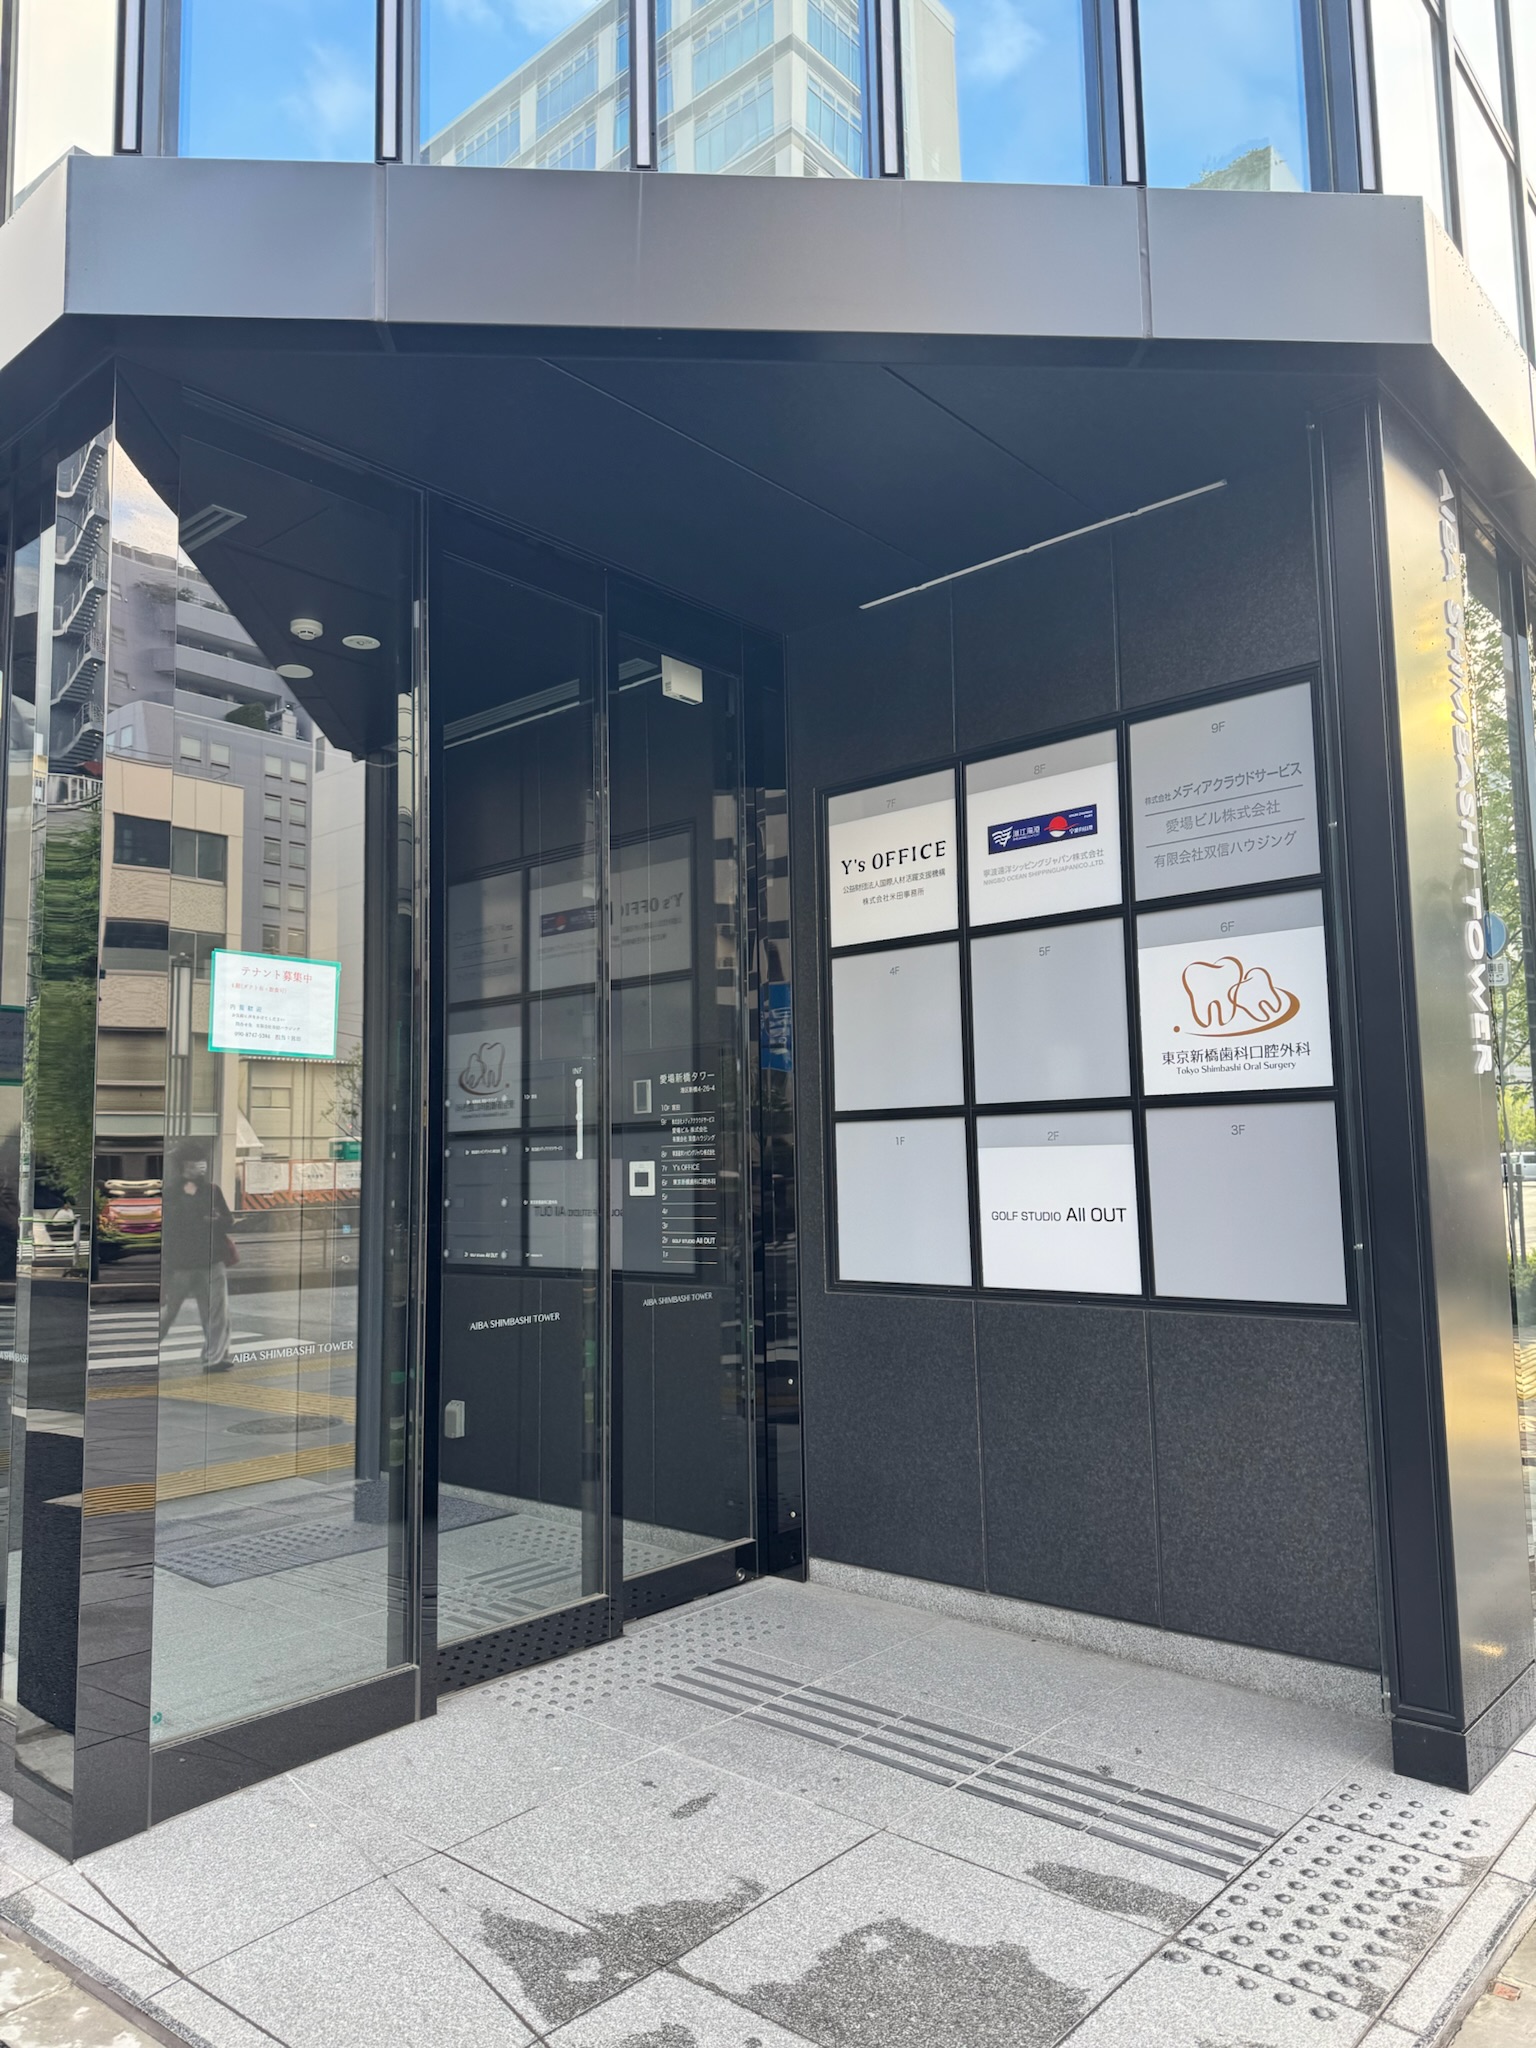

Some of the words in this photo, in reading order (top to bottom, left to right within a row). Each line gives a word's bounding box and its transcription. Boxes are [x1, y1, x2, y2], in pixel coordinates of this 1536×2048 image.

[1438, 468, 1457, 582] AIBA
[1211, 721, 1226, 734] 9F
[1444, 599, 1478, 868] SHIMBASHI
[1033, 763, 1046, 775] 8F
[886, 799, 896, 809] 7F
[1165, 799, 1281, 834] 愛場ビル株式会社
[1153, 830, 1298, 869] 有限会社双信ハウジング
[841, 858, 866, 875] Y's
[872, 840, 947, 870] OFFICE
[1006, 872, 1027, 882] OCEAN
[1220, 920, 1235, 933] 6F
[1038, 946, 1051, 957] 5F
[241, 966, 313, 984] テナント募集中
[889, 966, 900, 976] 4F
[1462, 888, 1491, 1074] TOWER
[1161, 1041, 1311, 1066] 東京新橋歯科口腔外科
[1176, 1066, 1200, 1076] Tokyo
[1201, 1063, 1241, 1073] Shimbashi
[1243, 1061, 1262, 1071] Oral
[1263, 1060, 1297, 1071] Surgery
[659, 1071, 715, 1085] 愛場新橋タワー
[1047, 1131, 1059, 1141] 2F
[1230, 1123, 1246, 1136] 3F
[895, 1136, 905, 1146] 1F
[991, 1210, 1018, 1221] GOLF
[1020, 1211, 1062, 1222] STUDIO
[1090, 1207, 1127, 1223] OUT
[658, 1294, 691, 1306] SHIMBASHI
[691, 1291, 713, 1302] TOWER
[469, 1320, 489, 1331] AIBA
[490, 1314, 532, 1329] SHIMBASHI
[532, 1312, 561, 1323] TOWER
[231, 1352, 258, 1364] AIBA
[259, 1344, 316, 1361] SHIMBASHI
[318, 1340, 354, 1353] TOWER
